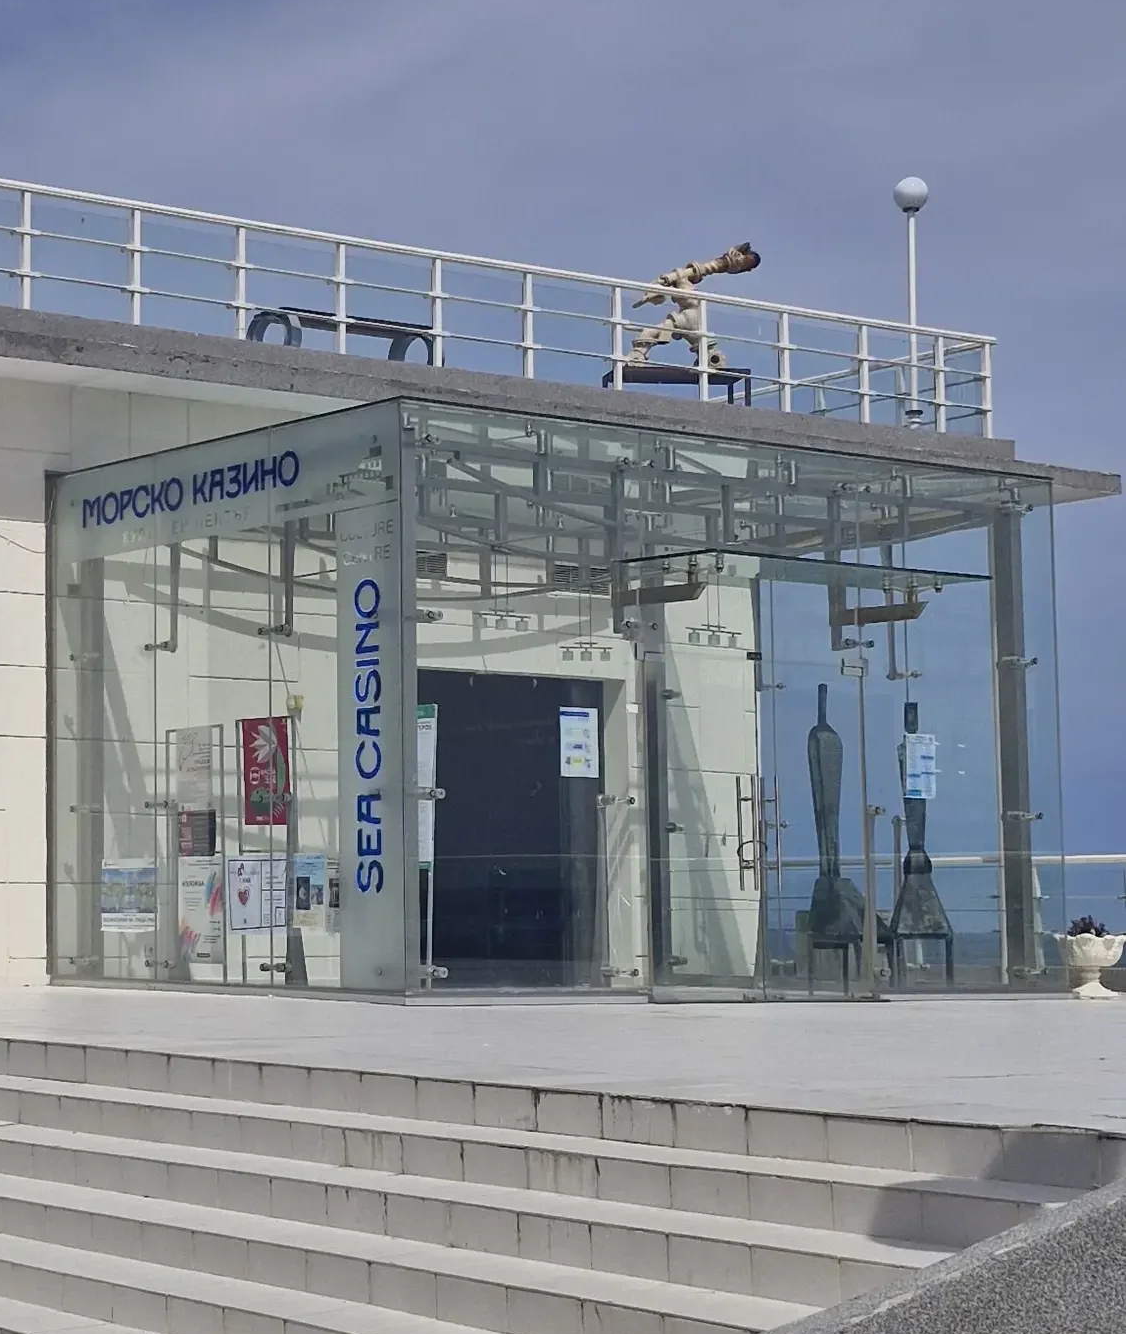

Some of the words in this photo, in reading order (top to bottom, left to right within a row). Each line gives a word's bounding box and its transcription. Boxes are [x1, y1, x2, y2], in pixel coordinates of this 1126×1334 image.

[82, 477, 184, 529] МОРСКО
[192, 449, 301, 505] КАЗИНО
[354, 578, 382, 780] CASINO
[357, 789, 384, 895] SEA
